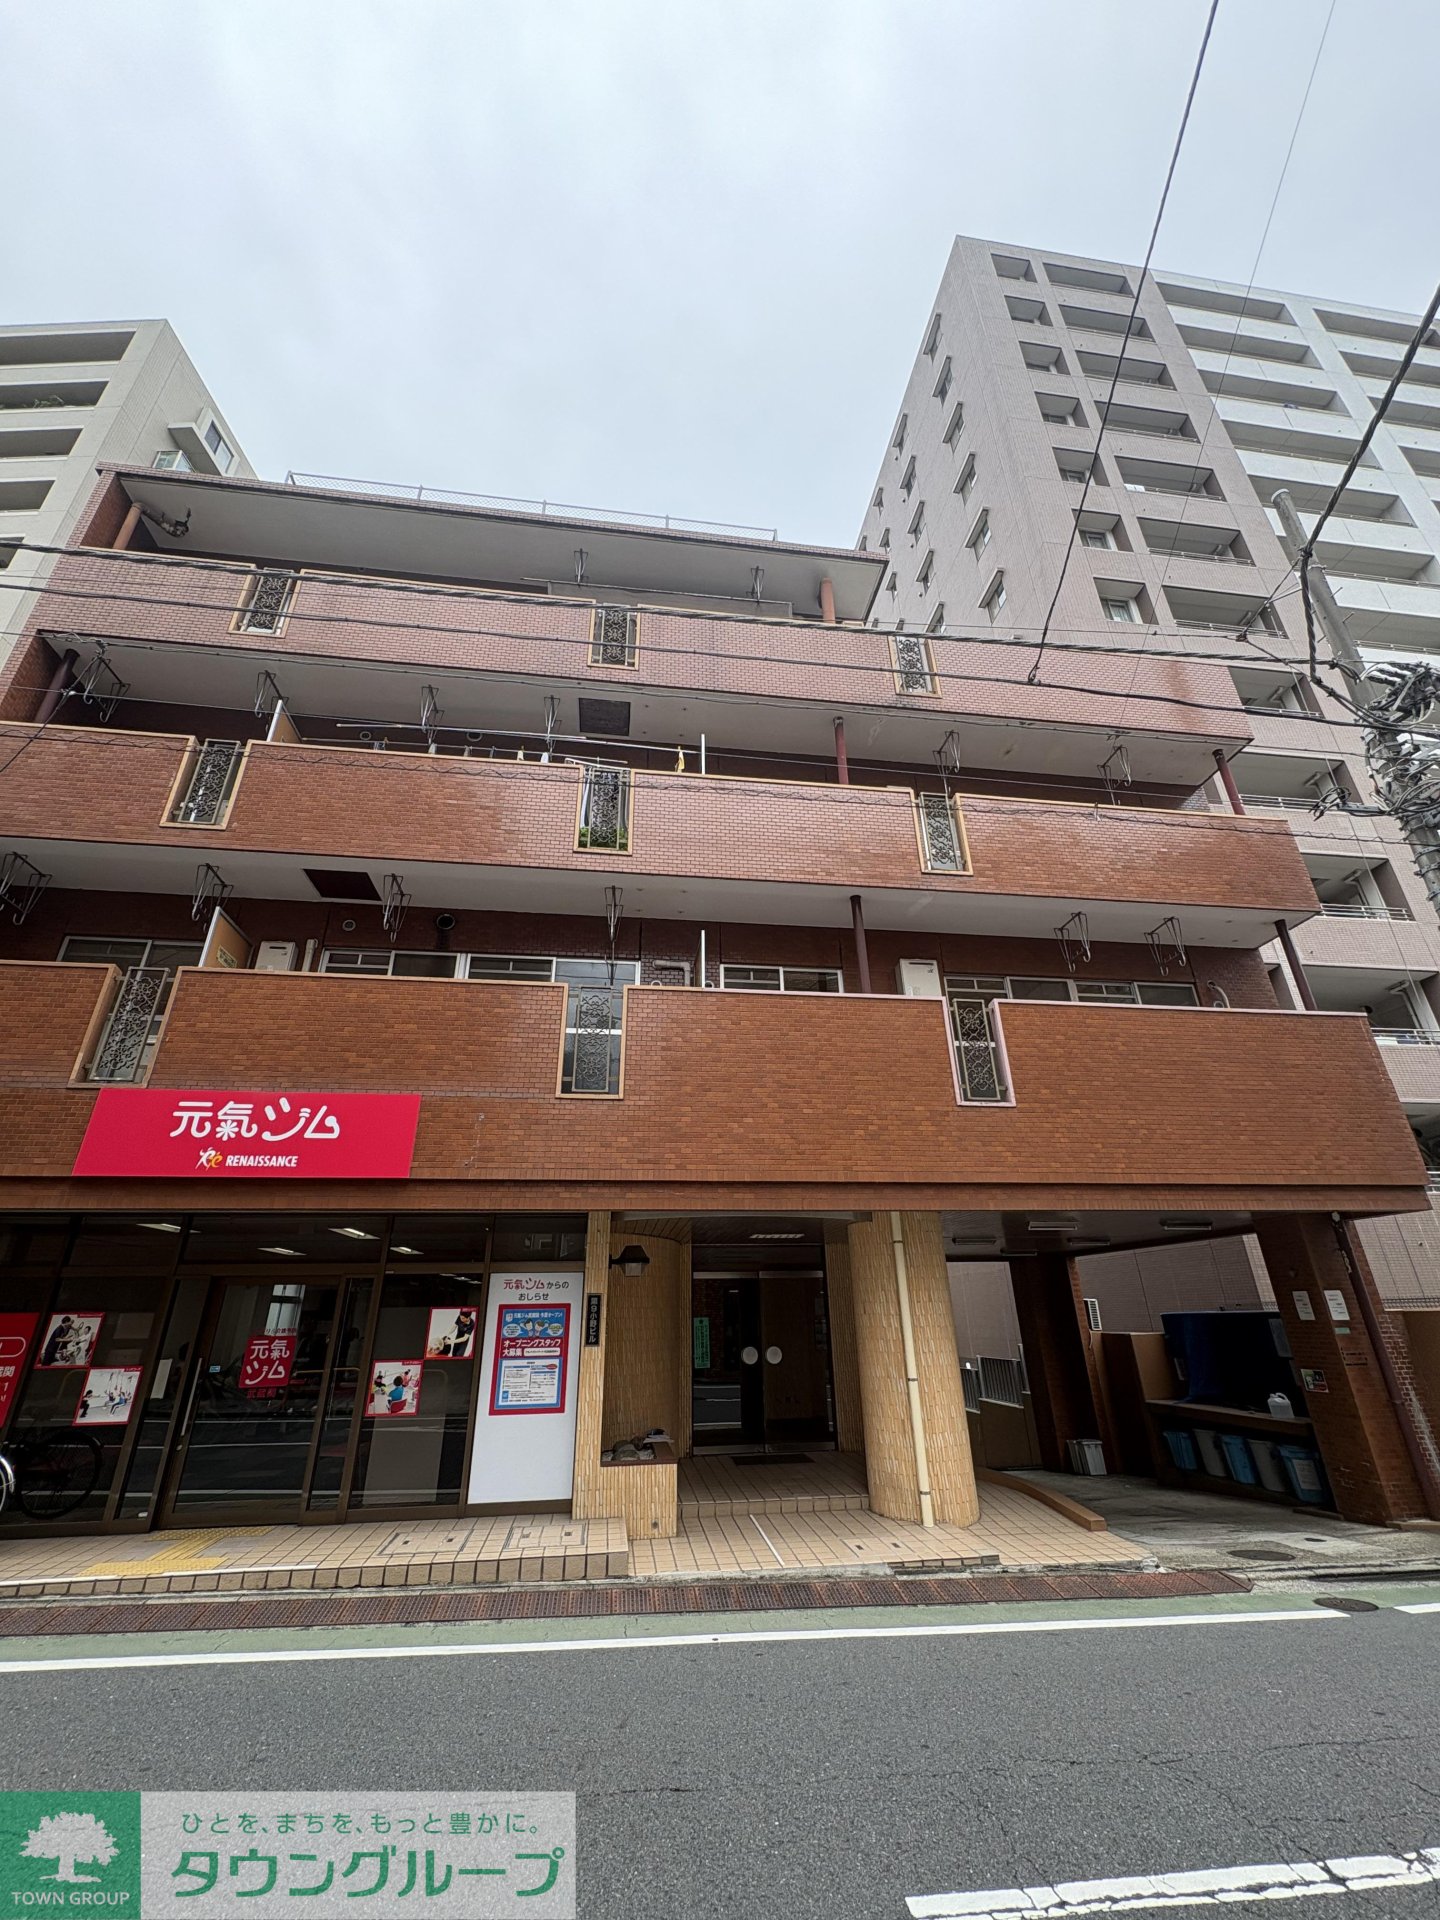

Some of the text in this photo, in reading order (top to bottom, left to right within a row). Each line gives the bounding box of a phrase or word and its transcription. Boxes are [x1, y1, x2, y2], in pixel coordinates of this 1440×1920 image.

[169, 1097, 341, 1141] 元氣ジム
[225, 1155, 299, 1168] RENAISSANCE
[518, 1292, 549, 1301] おしらせ
[503, 1338, 562, 1348] オープニングスタッフ
[250, 1339, 290, 1361] 元氣
[502, 1347, 523, 1357] 大募集
[245, 1360, 286, 1385] ジム
